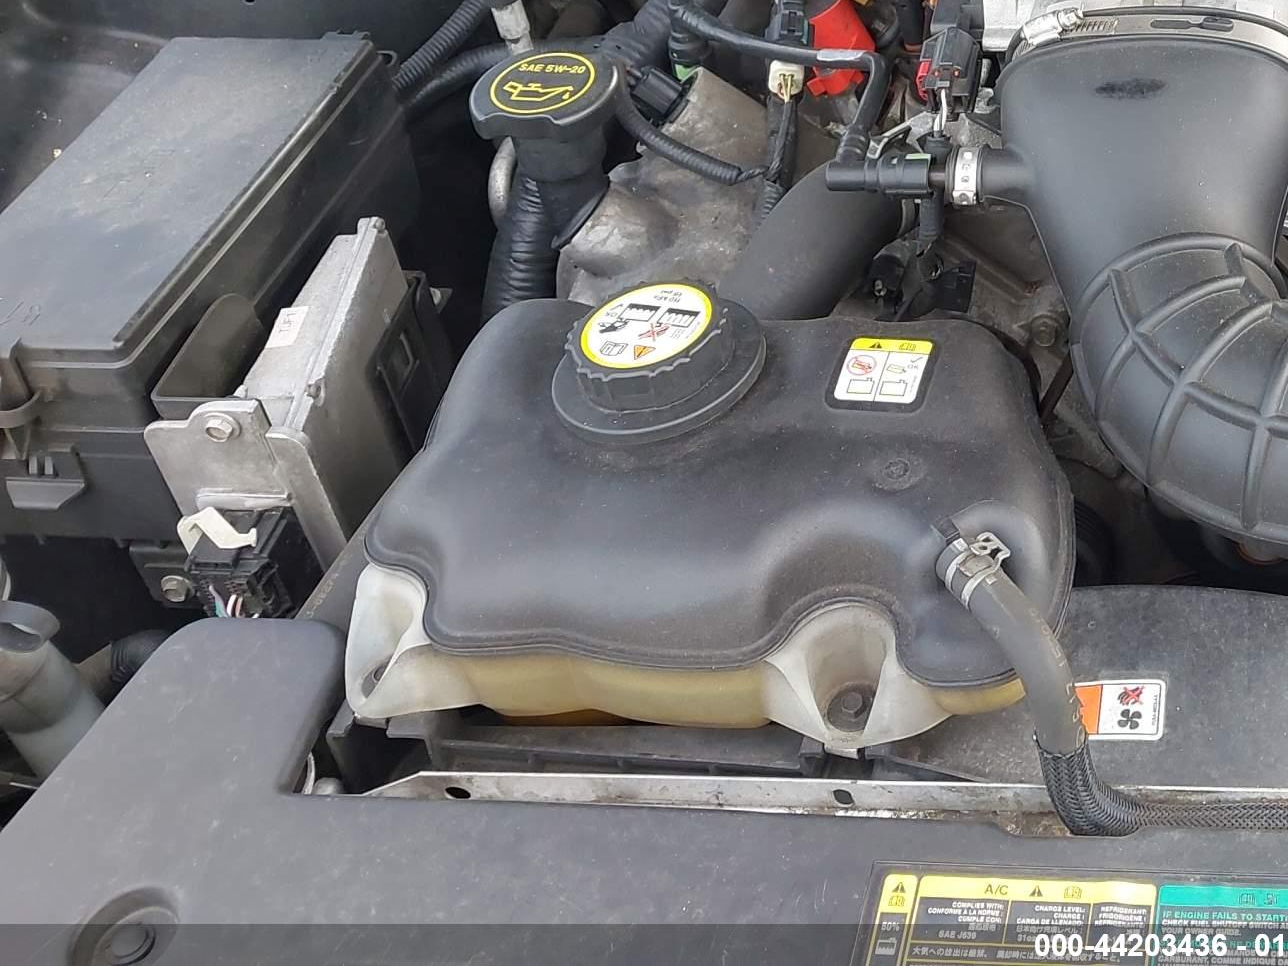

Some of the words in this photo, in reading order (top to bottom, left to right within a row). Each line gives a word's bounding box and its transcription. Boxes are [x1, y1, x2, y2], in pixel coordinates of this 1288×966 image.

[518, 63, 544, 72] SAE
[545, 64, 586, 74] 5W-20
[984, 883, 1009, 896] A/C
[1173, 911, 1209, 920] ENGINE
[1211, 912, 1238, 921] FAILS
[1240, 913, 1253, 921] TO
[880, 921, 900, 932] 50%
